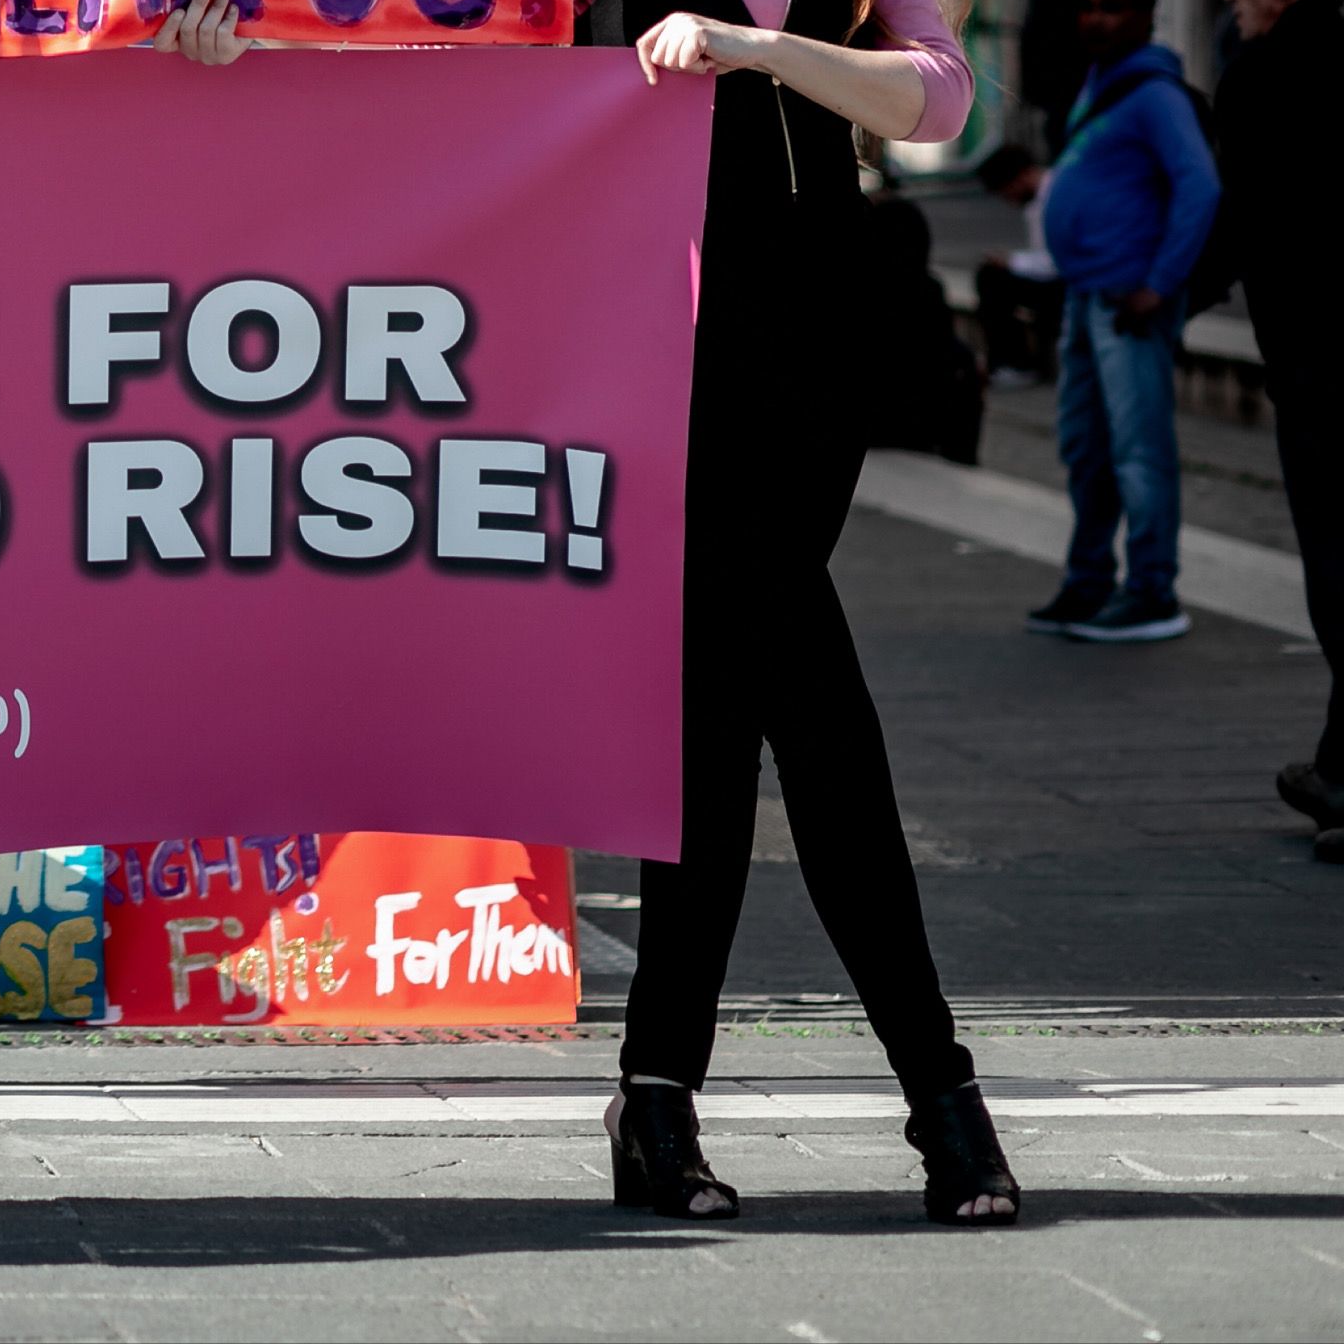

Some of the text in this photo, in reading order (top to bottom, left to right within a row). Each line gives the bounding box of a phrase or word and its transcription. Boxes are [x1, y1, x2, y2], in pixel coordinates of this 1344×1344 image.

[67, 278, 468, 406] FOR
[85, 435, 609, 573] RISE!
[164, 907, 350, 1023] Fight
